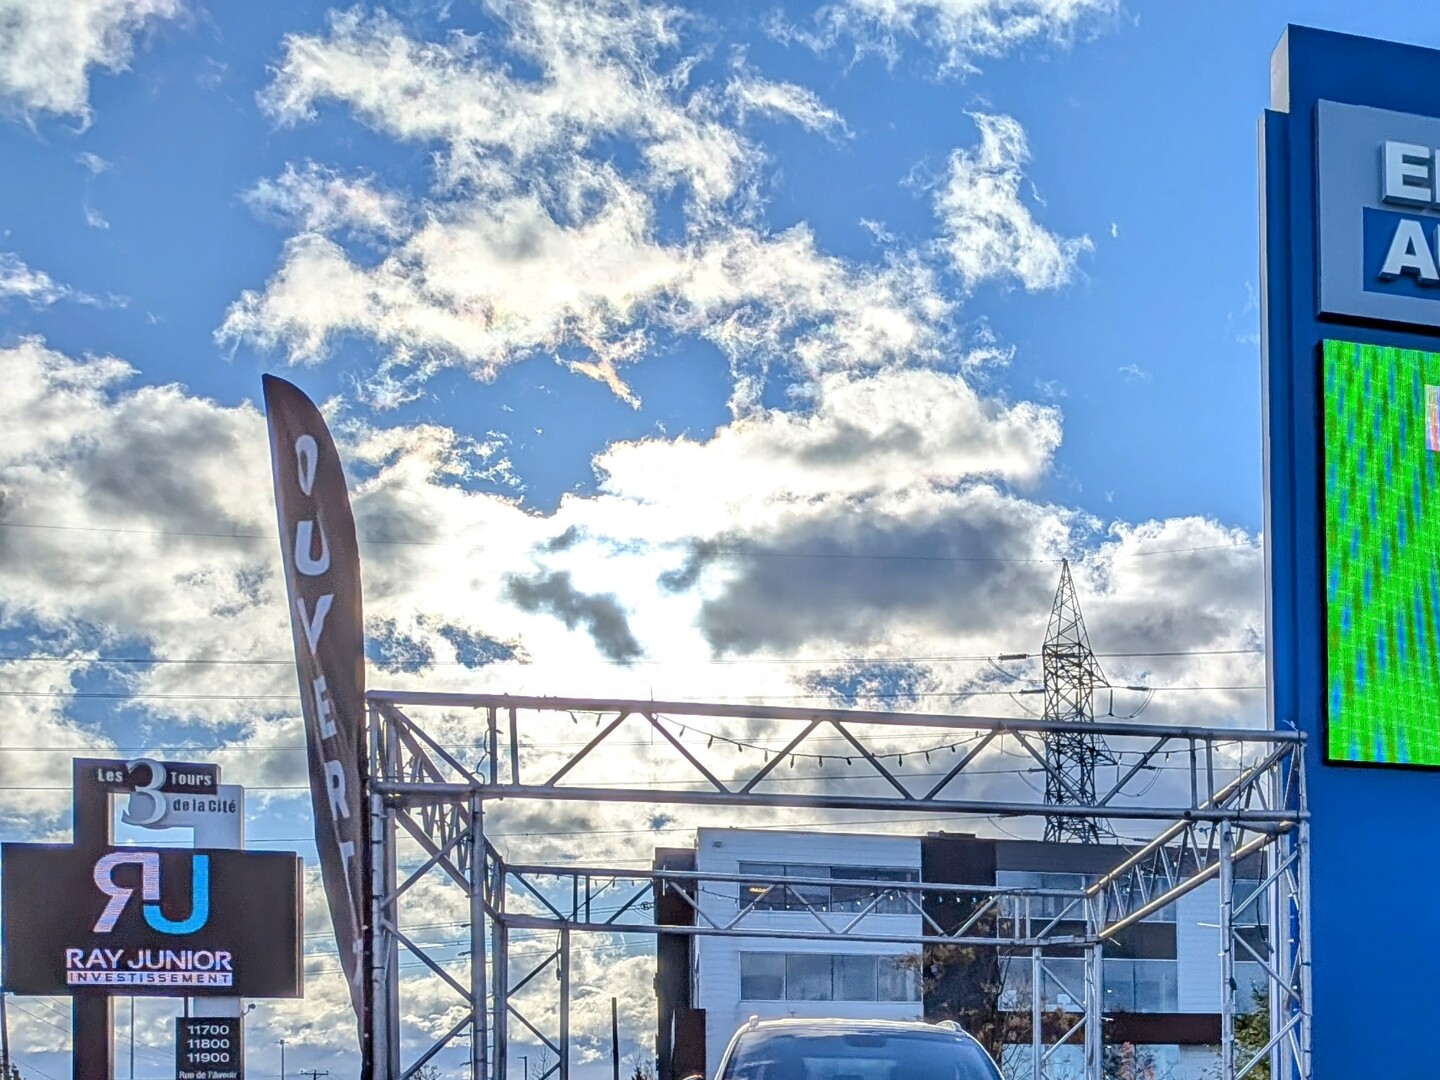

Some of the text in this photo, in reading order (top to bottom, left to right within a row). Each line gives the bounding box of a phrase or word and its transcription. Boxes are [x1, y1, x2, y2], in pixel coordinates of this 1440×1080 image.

[97, 758, 212, 828] Les 3 Tours
[173, 797, 236, 814] de la Cité
[66, 948, 234, 971] RAY JUNIOR
[69, 972, 231, 985] INVESTISSEMENT
[187, 1025, 230, 1035] 11700
[187, 1039, 230, 1049] 11800
[187, 1052, 230, 1063] 11900
